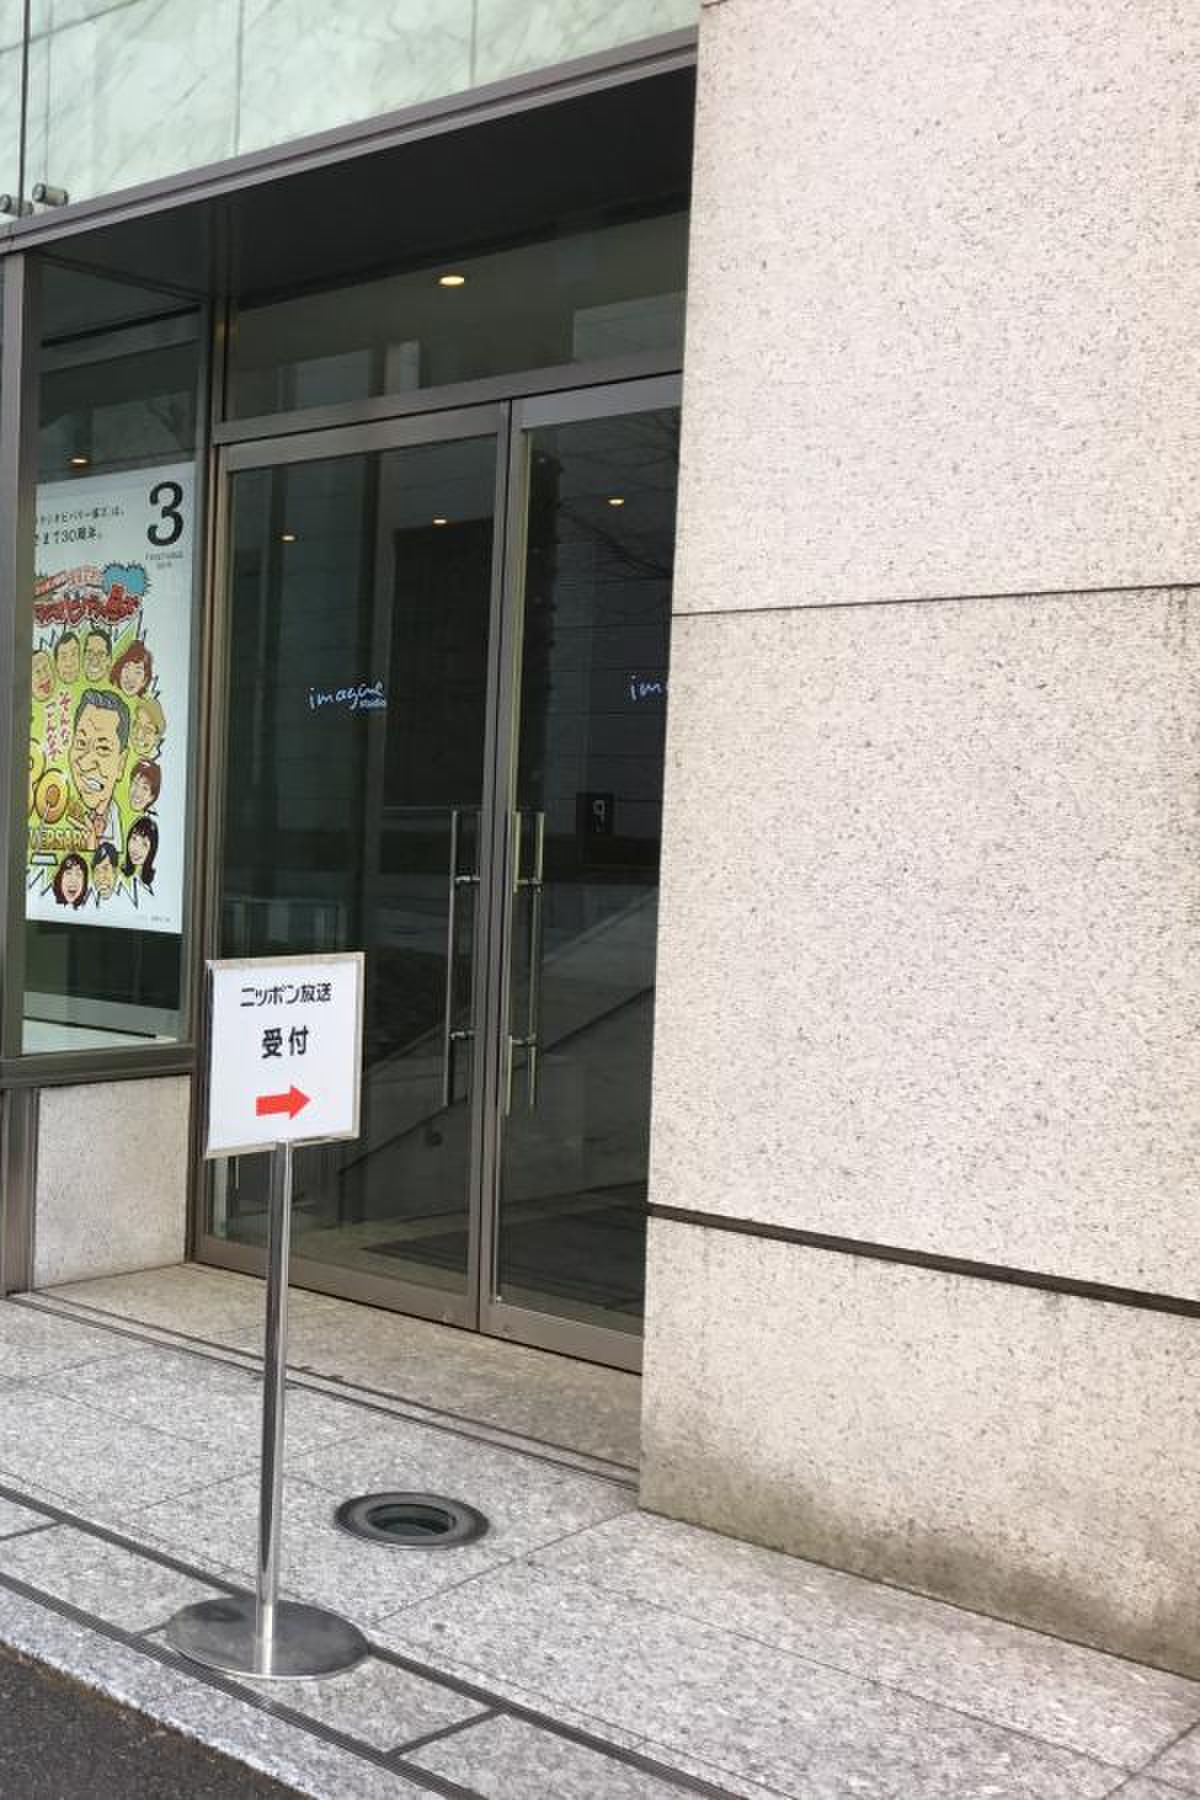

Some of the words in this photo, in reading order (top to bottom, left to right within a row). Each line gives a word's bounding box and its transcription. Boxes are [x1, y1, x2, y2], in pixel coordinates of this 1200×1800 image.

[147, 481, 184, 546] 3
[240, 982, 332, 1007] ニッポン放送
[261, 1025, 309, 1059] 受付
